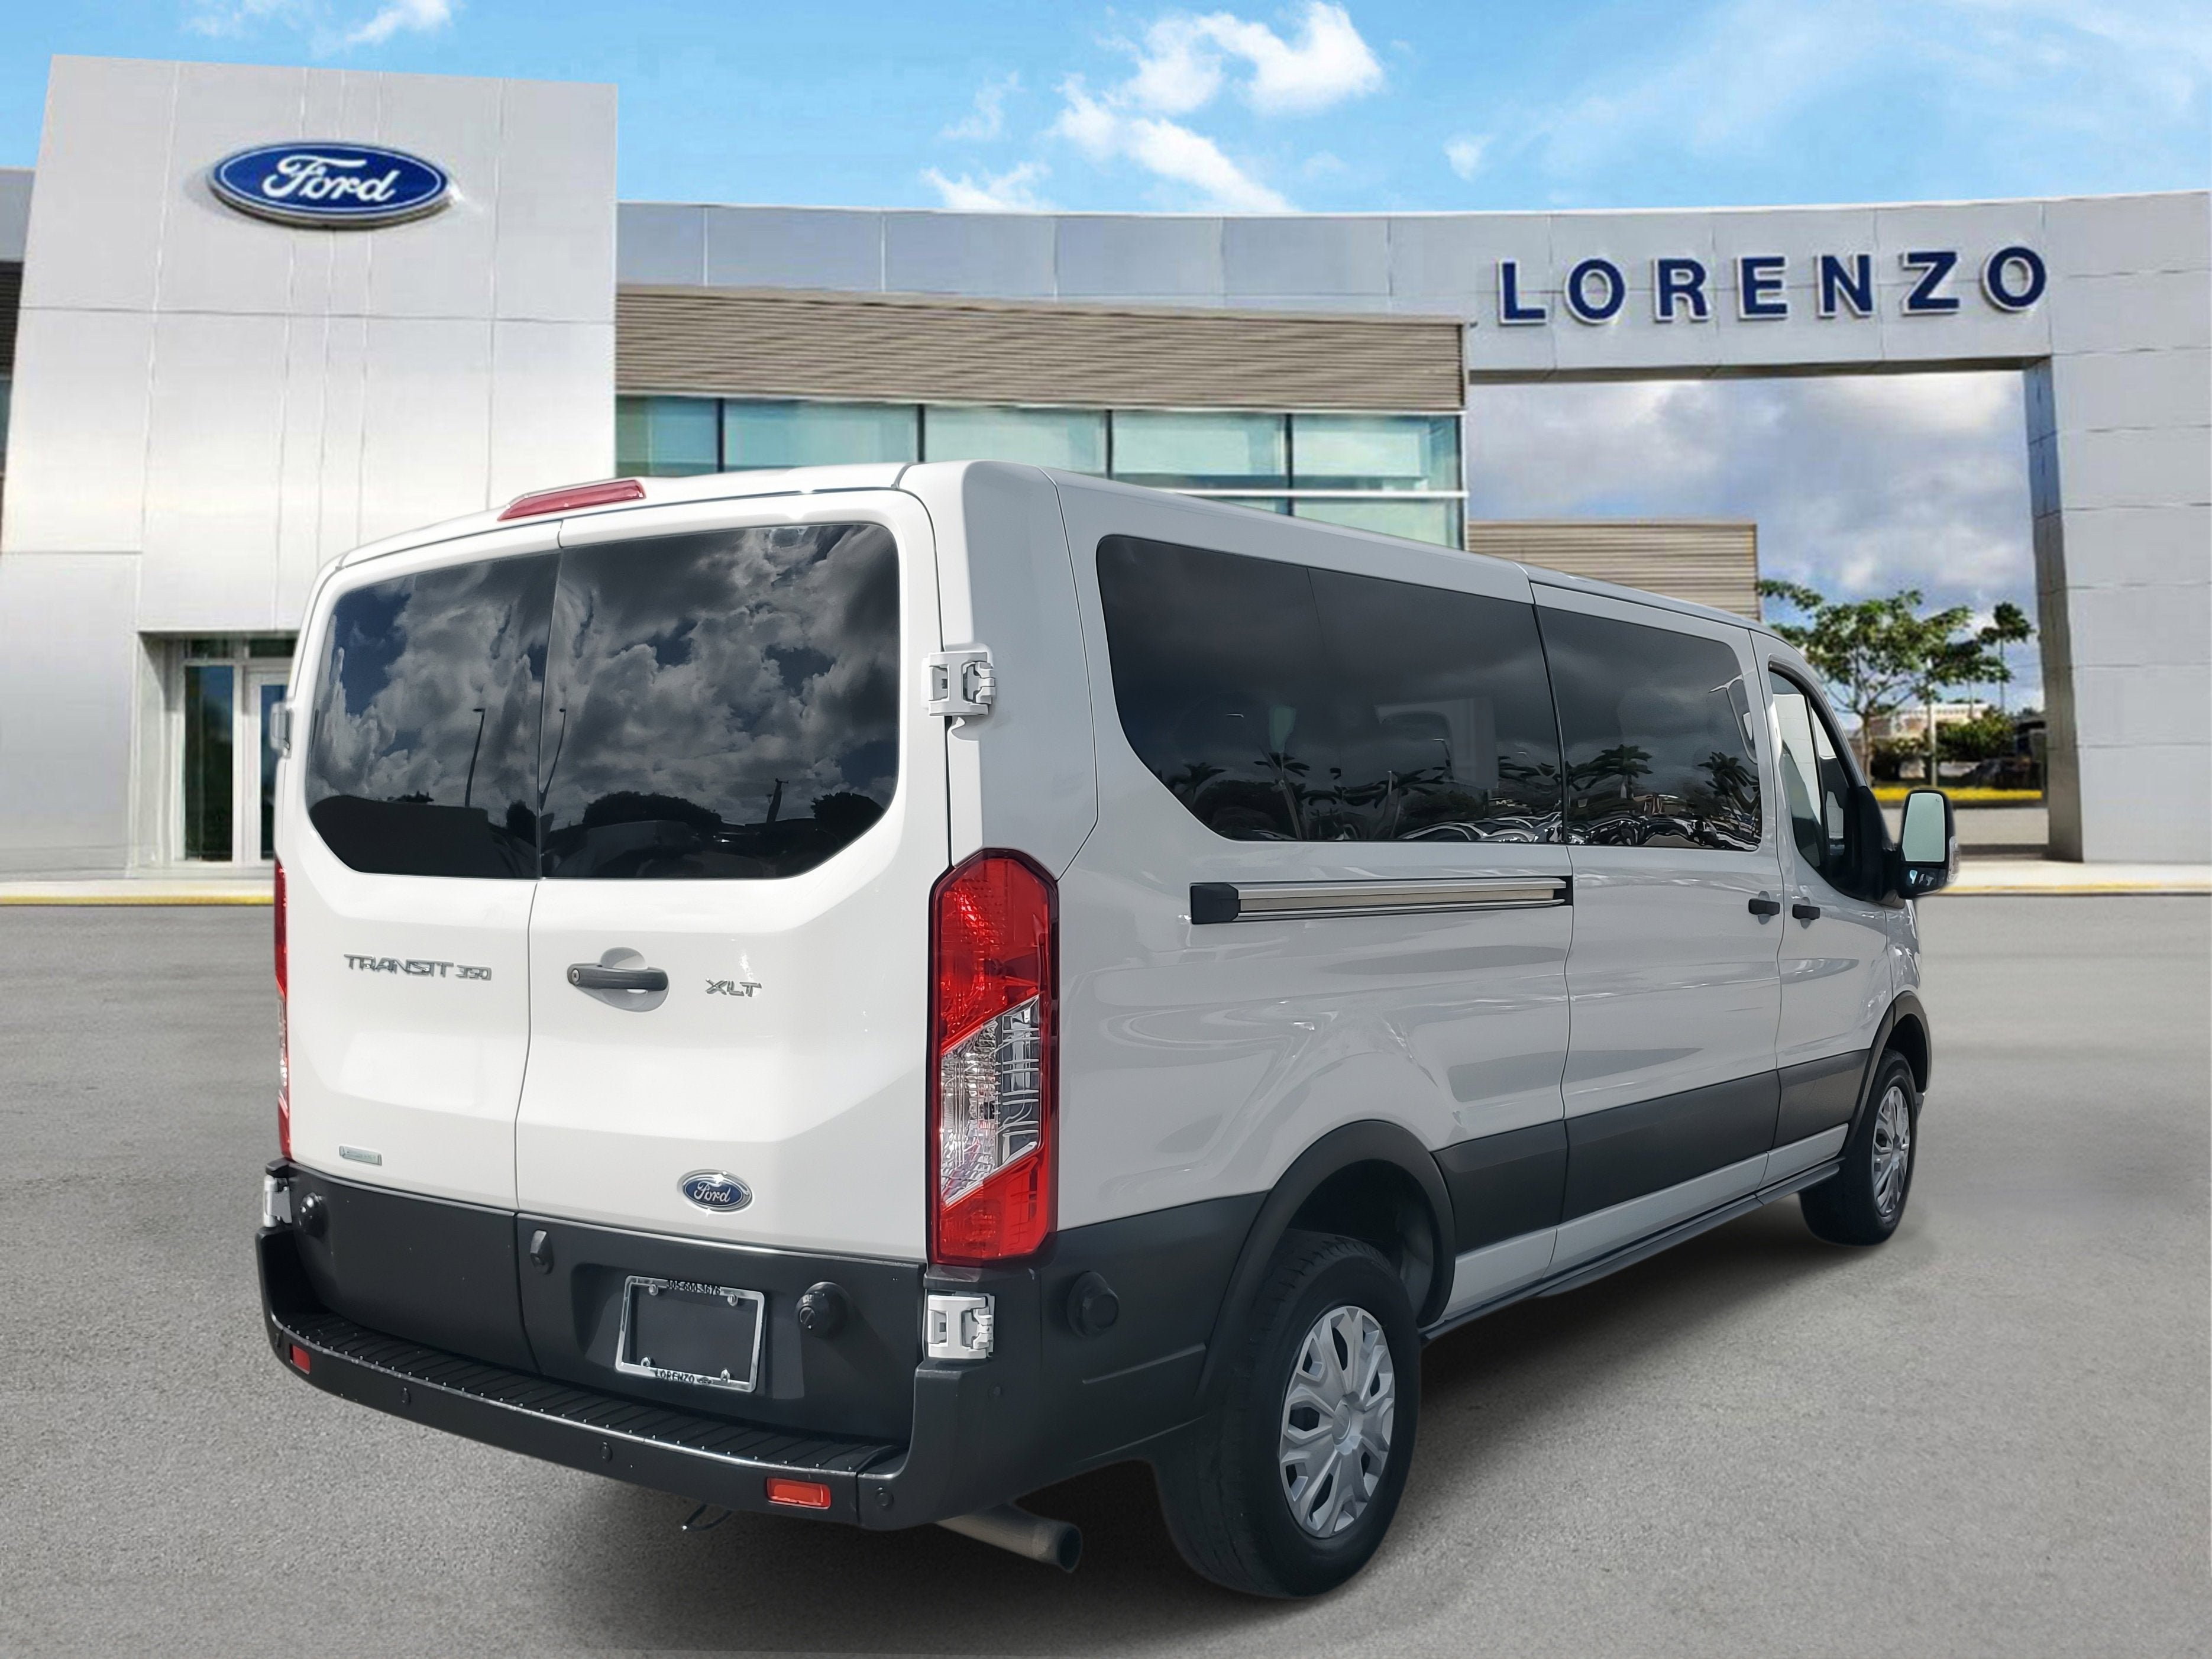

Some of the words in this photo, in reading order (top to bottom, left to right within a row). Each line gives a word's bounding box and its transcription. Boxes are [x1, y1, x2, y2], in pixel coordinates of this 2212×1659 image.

[262, 155, 401, 202] Ford
[1498, 245, 2048, 324] LORENZO
[344, 953, 454, 978] TRANSIT
[455, 965, 492, 981] 350
[705, 979, 762, 997] XLT
[694, 1181, 731, 1202] Ford
[655, 1369, 695, 1383] LORENZO
